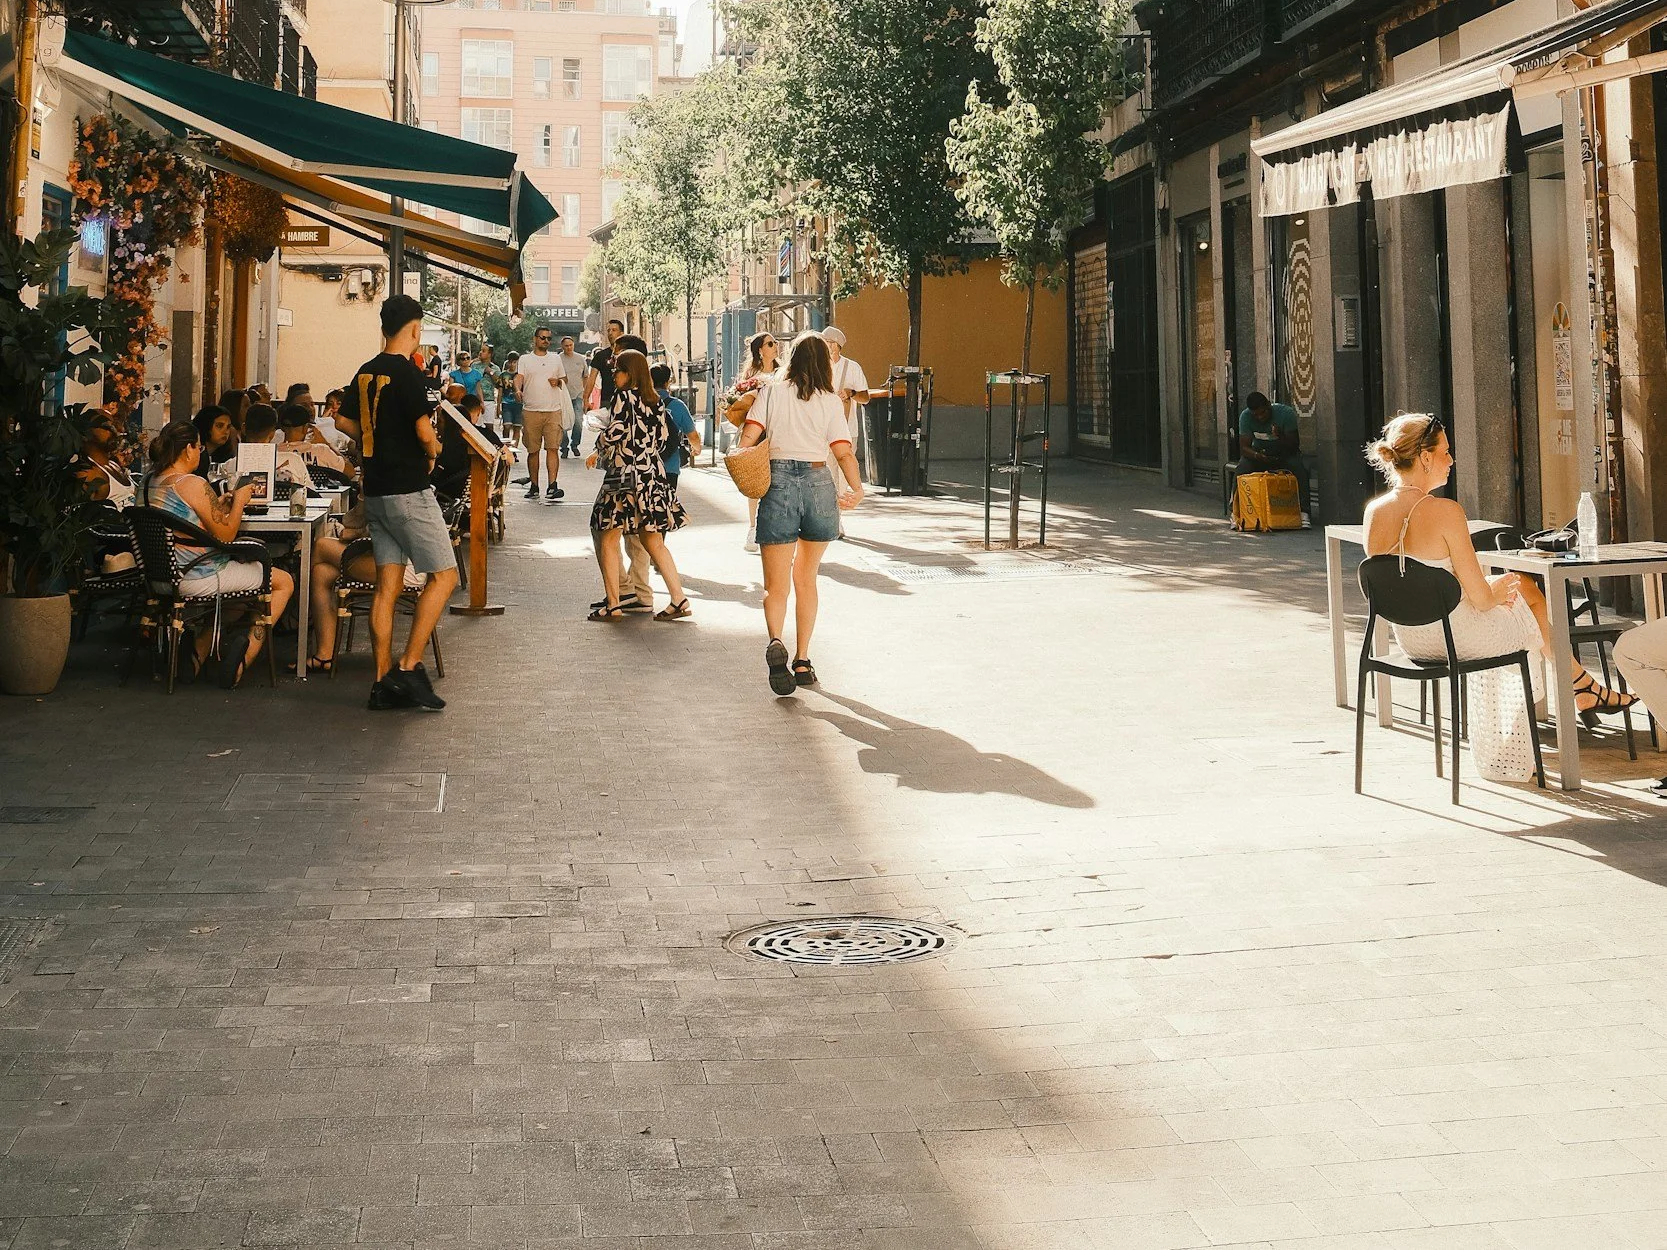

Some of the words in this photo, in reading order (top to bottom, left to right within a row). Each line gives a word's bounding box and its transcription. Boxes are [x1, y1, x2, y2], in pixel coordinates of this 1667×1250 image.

[1405, 124, 1493, 172] RESTAURANT
[287, 231, 319, 241] HAMBRE
[534, 308, 579, 318] COFFEE
